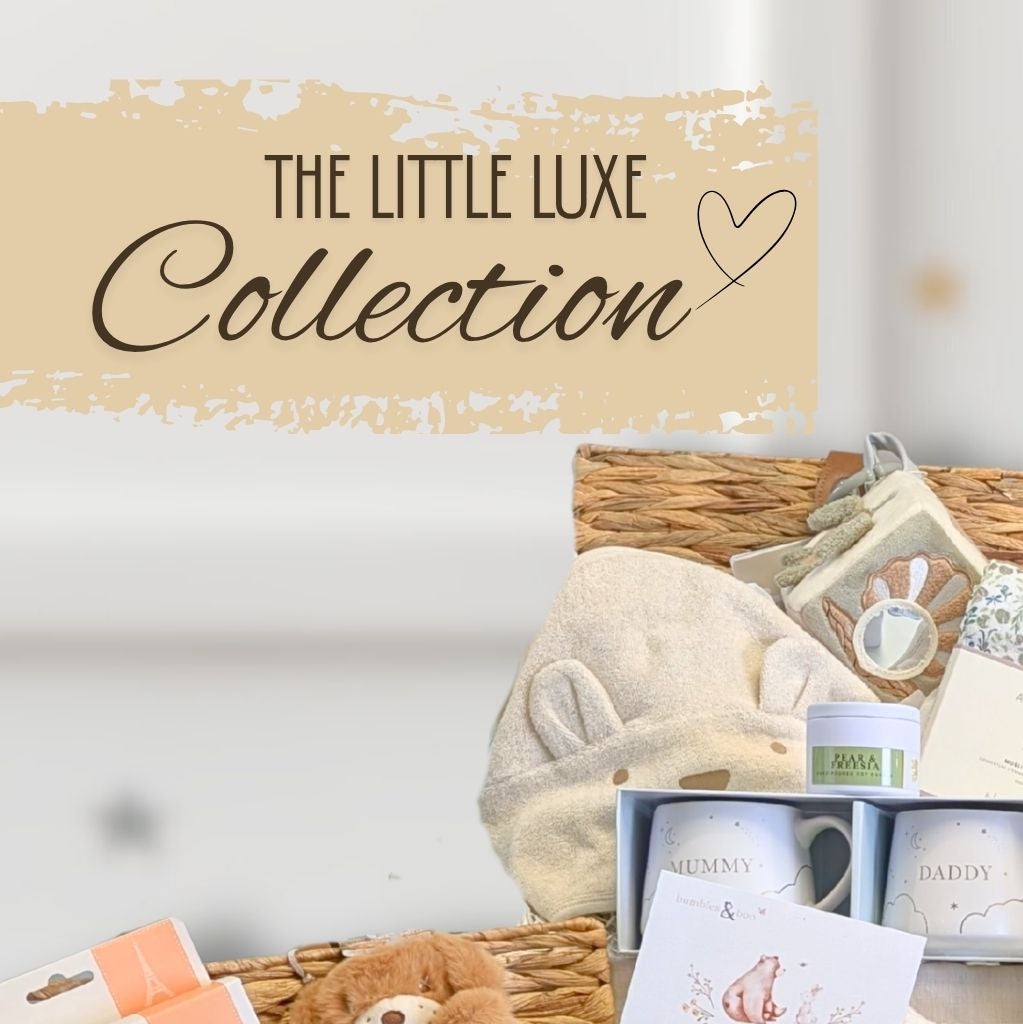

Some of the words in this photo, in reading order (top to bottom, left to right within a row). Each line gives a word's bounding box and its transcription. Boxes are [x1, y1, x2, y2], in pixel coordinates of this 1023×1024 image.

[831, 761, 881, 771] FREESIA
[834, 753, 865, 763] PEAR
[869, 754, 877, 763] &
[671, 857, 753, 876] MUMMY
[918, 865, 993, 882] DADDY
[720, 900, 735, 921] &
